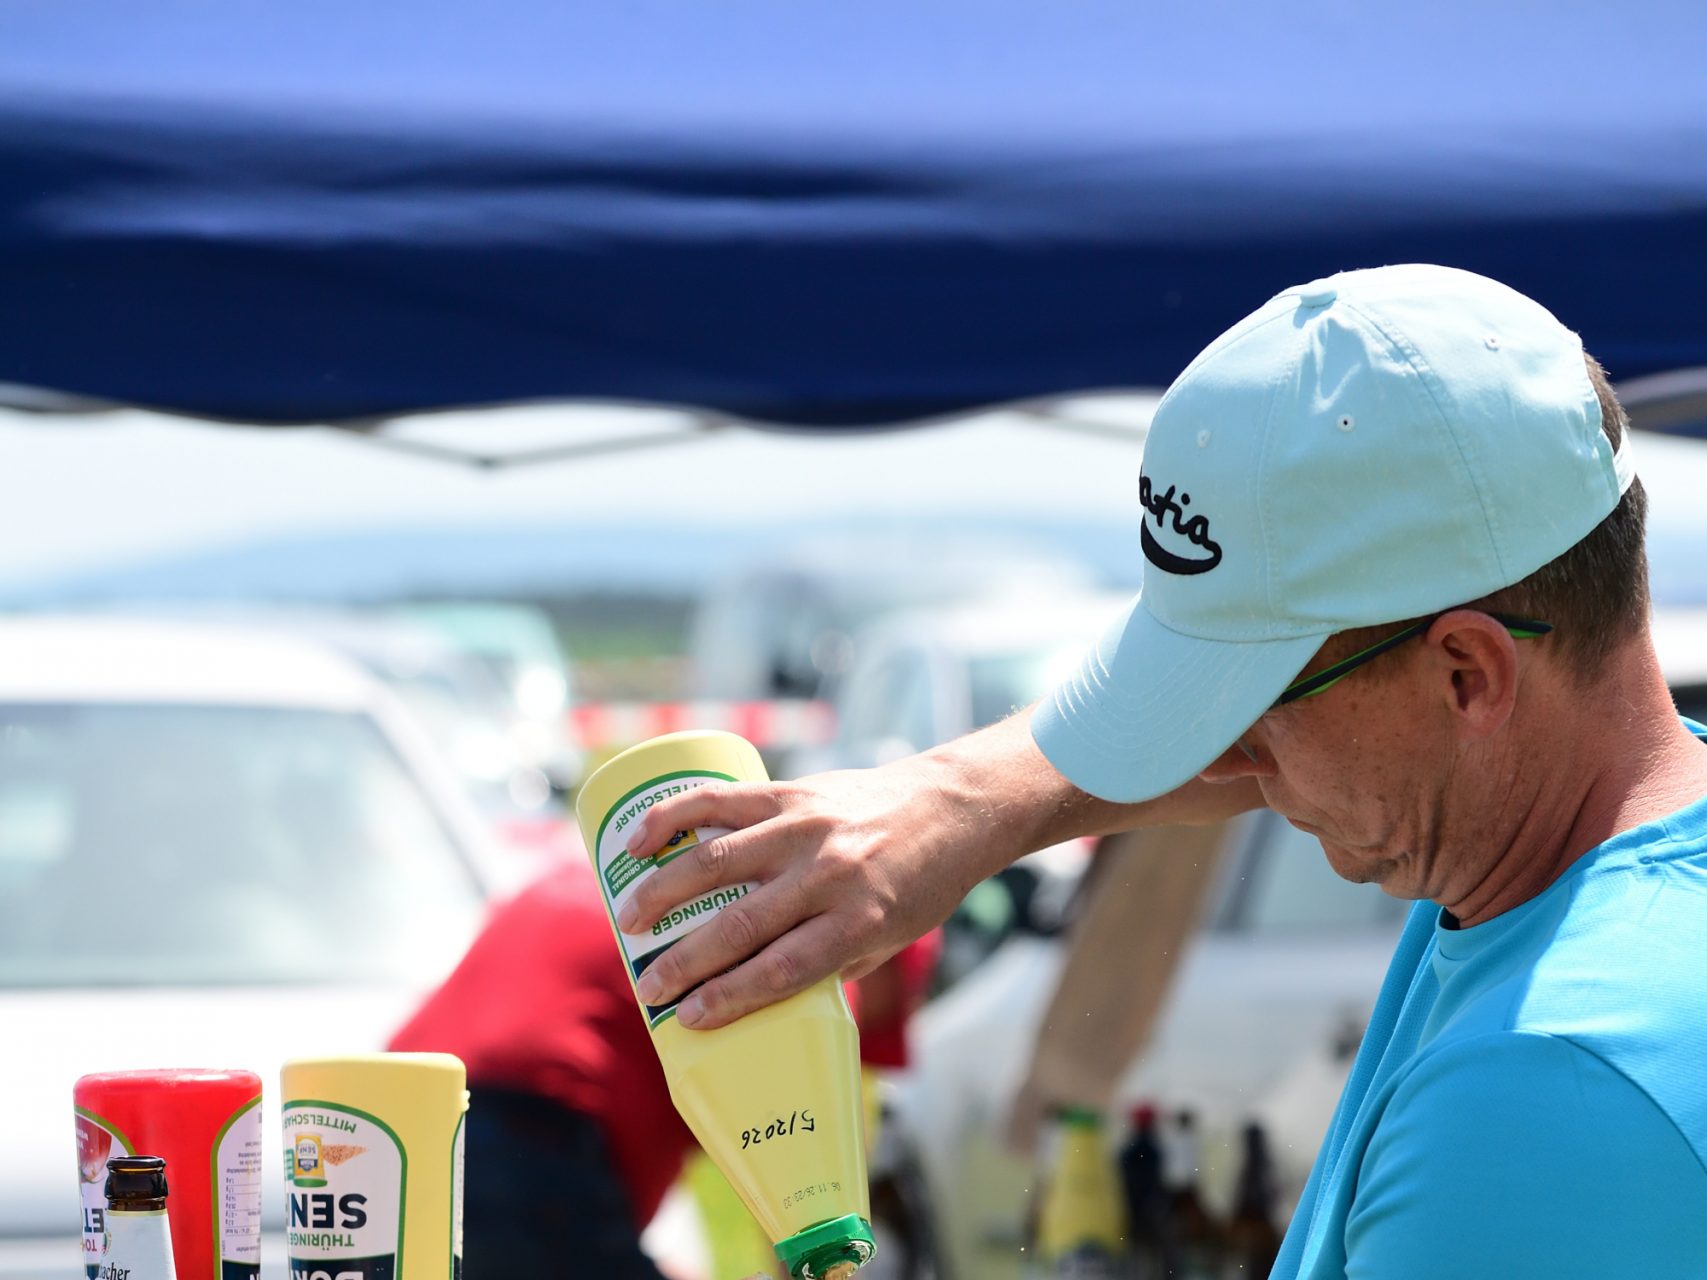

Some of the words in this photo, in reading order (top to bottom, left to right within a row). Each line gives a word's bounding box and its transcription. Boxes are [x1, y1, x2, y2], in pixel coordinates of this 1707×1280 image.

[1139, 466, 1222, 552] atia
[614, 782, 705, 832] ELSCHARF
[611, 863, 641, 891] ORIGINAL
[741, 1109, 815, 1150] 5/2026
[286, 1192, 368, 1229] SEN
[290, 1234, 355, 1251] THÜRINGE
